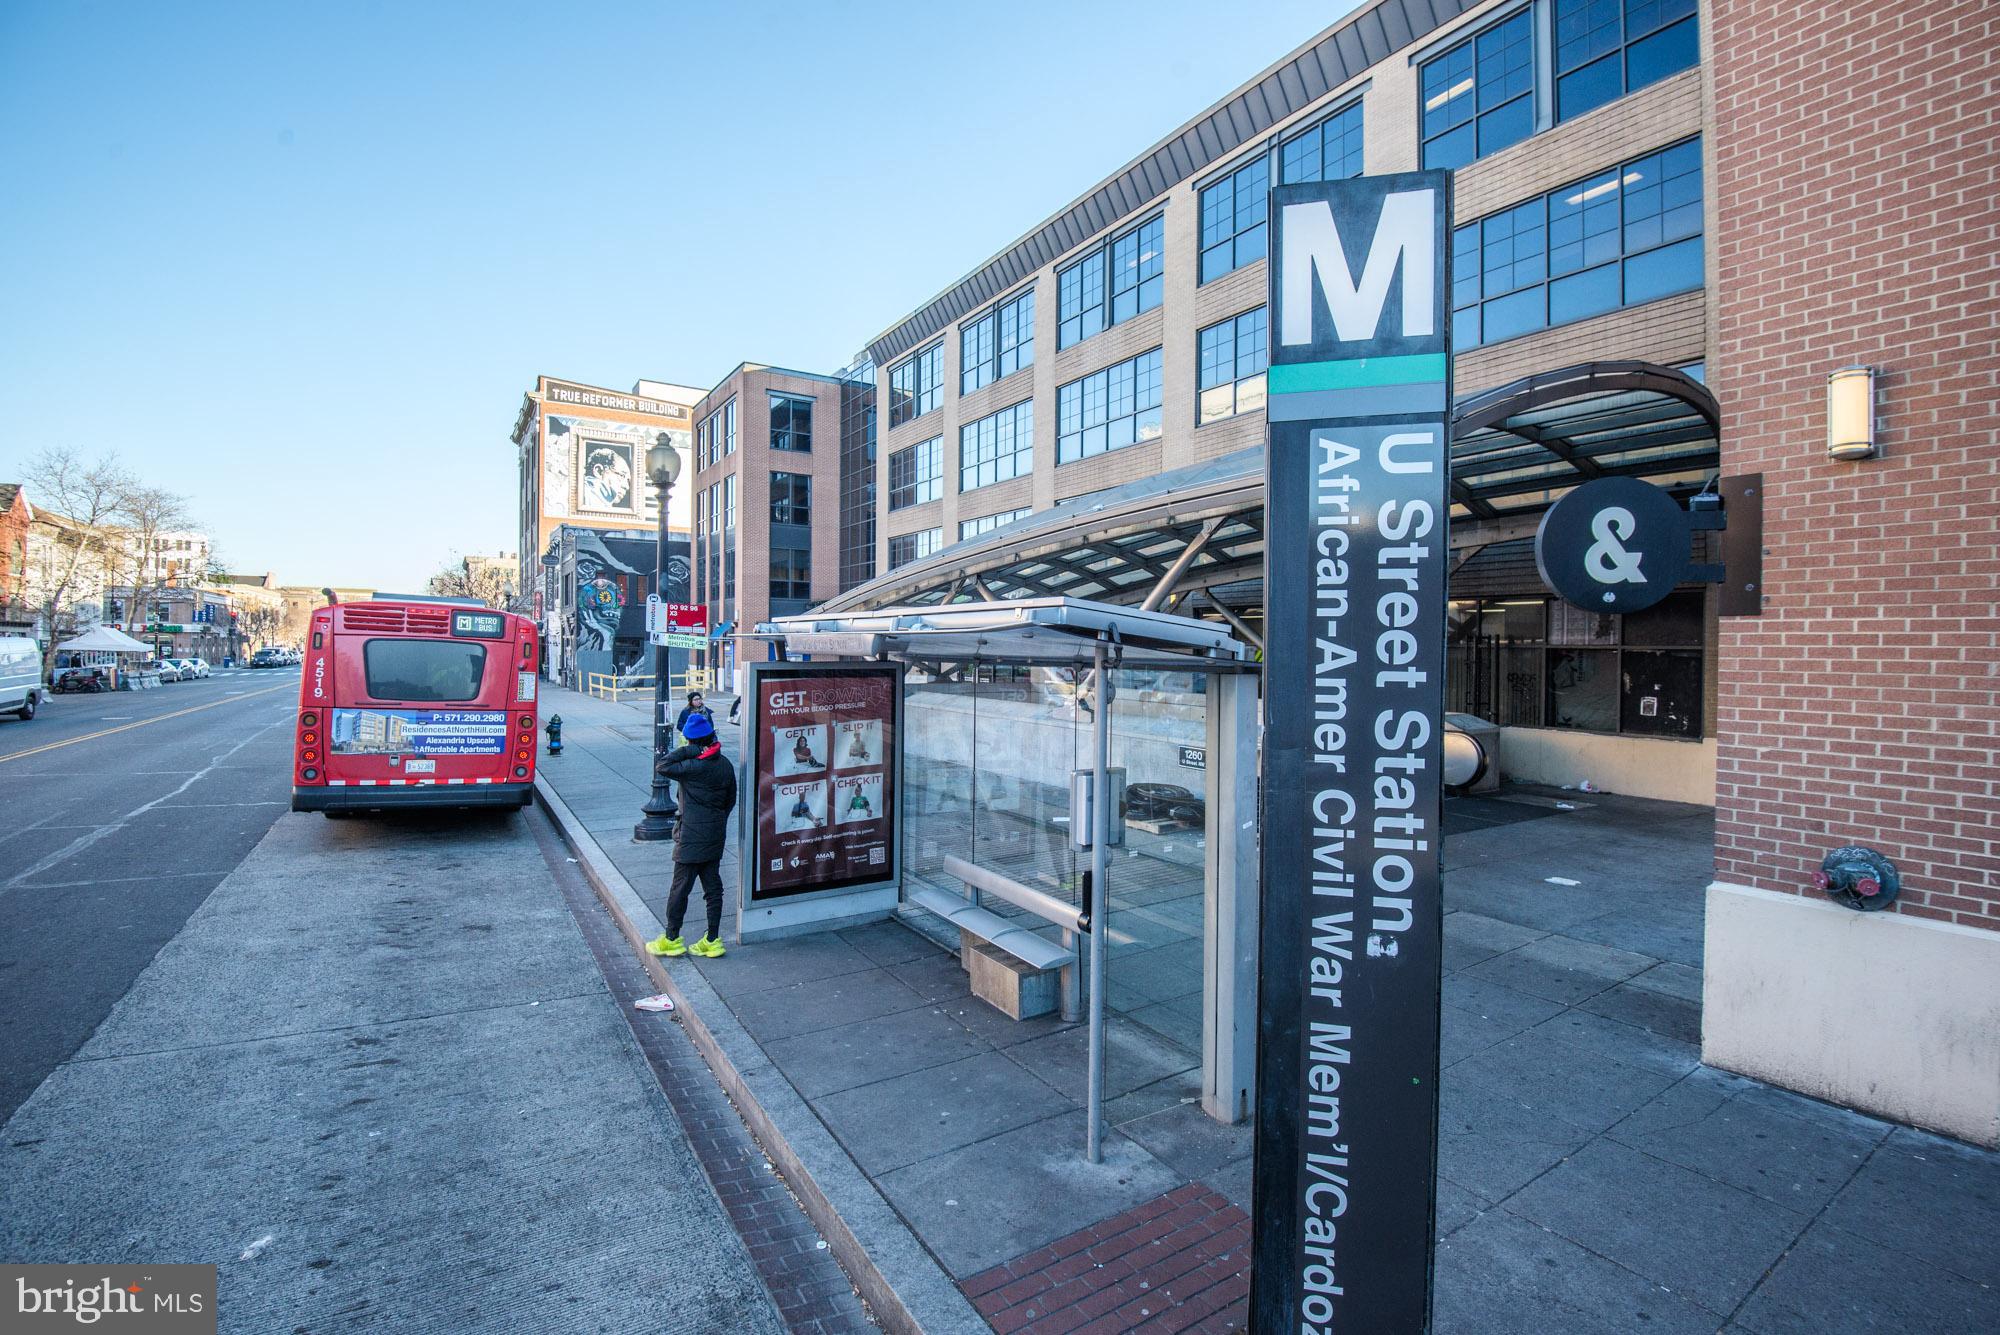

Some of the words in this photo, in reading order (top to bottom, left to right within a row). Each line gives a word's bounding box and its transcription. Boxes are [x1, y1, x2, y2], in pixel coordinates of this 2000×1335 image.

[1281, 188, 1435, 347] M
[552, 388, 580, 402] TRUE
[582, 392, 636, 411] REFORMER
[638, 400, 680, 416] BUILDING
[1378, 431, 1434, 475] U
[1584, 505, 1648, 584] &
[1375, 498, 1434, 689] Street
[1313, 437, 1360, 774] African-Amer
[474, 616, 498, 625] METRO
[478, 624, 493, 632] BUS
[314, 657, 325, 698] 4519
[769, 690, 807, 708] GET
[811, 688, 867, 705] DOWN
[769, 707, 789, 715] WITH
[790, 706, 809, 714] YOUR
[811, 704, 833, 712] BLOOD
[835, 701, 866, 710] PRESSURE
[433, 713, 443, 722] P:
[444, 713, 505, 722] 571.290.2980
[402, 725, 505, 734] ResidencesAtNorthHill.com
[785, 729, 806, 739] GET
[807, 727, 817, 736] IT
[842, 724, 863, 732] SLIP
[866, 722, 874, 730] IT
[466, 737, 495, 745] Upscale
[459, 746, 501, 754] Apartments
[1185, 750, 1203, 760] 1260
[837, 777, 871, 789] CHECK
[872, 775, 881, 784] IT
[781, 784, 810, 796] CUFF
[811, 783, 820, 792] IT
[1372, 709, 1431, 932] Station
[1312, 788, 1357, 898] Civil
[1310, 911, 1353, 1009] War
